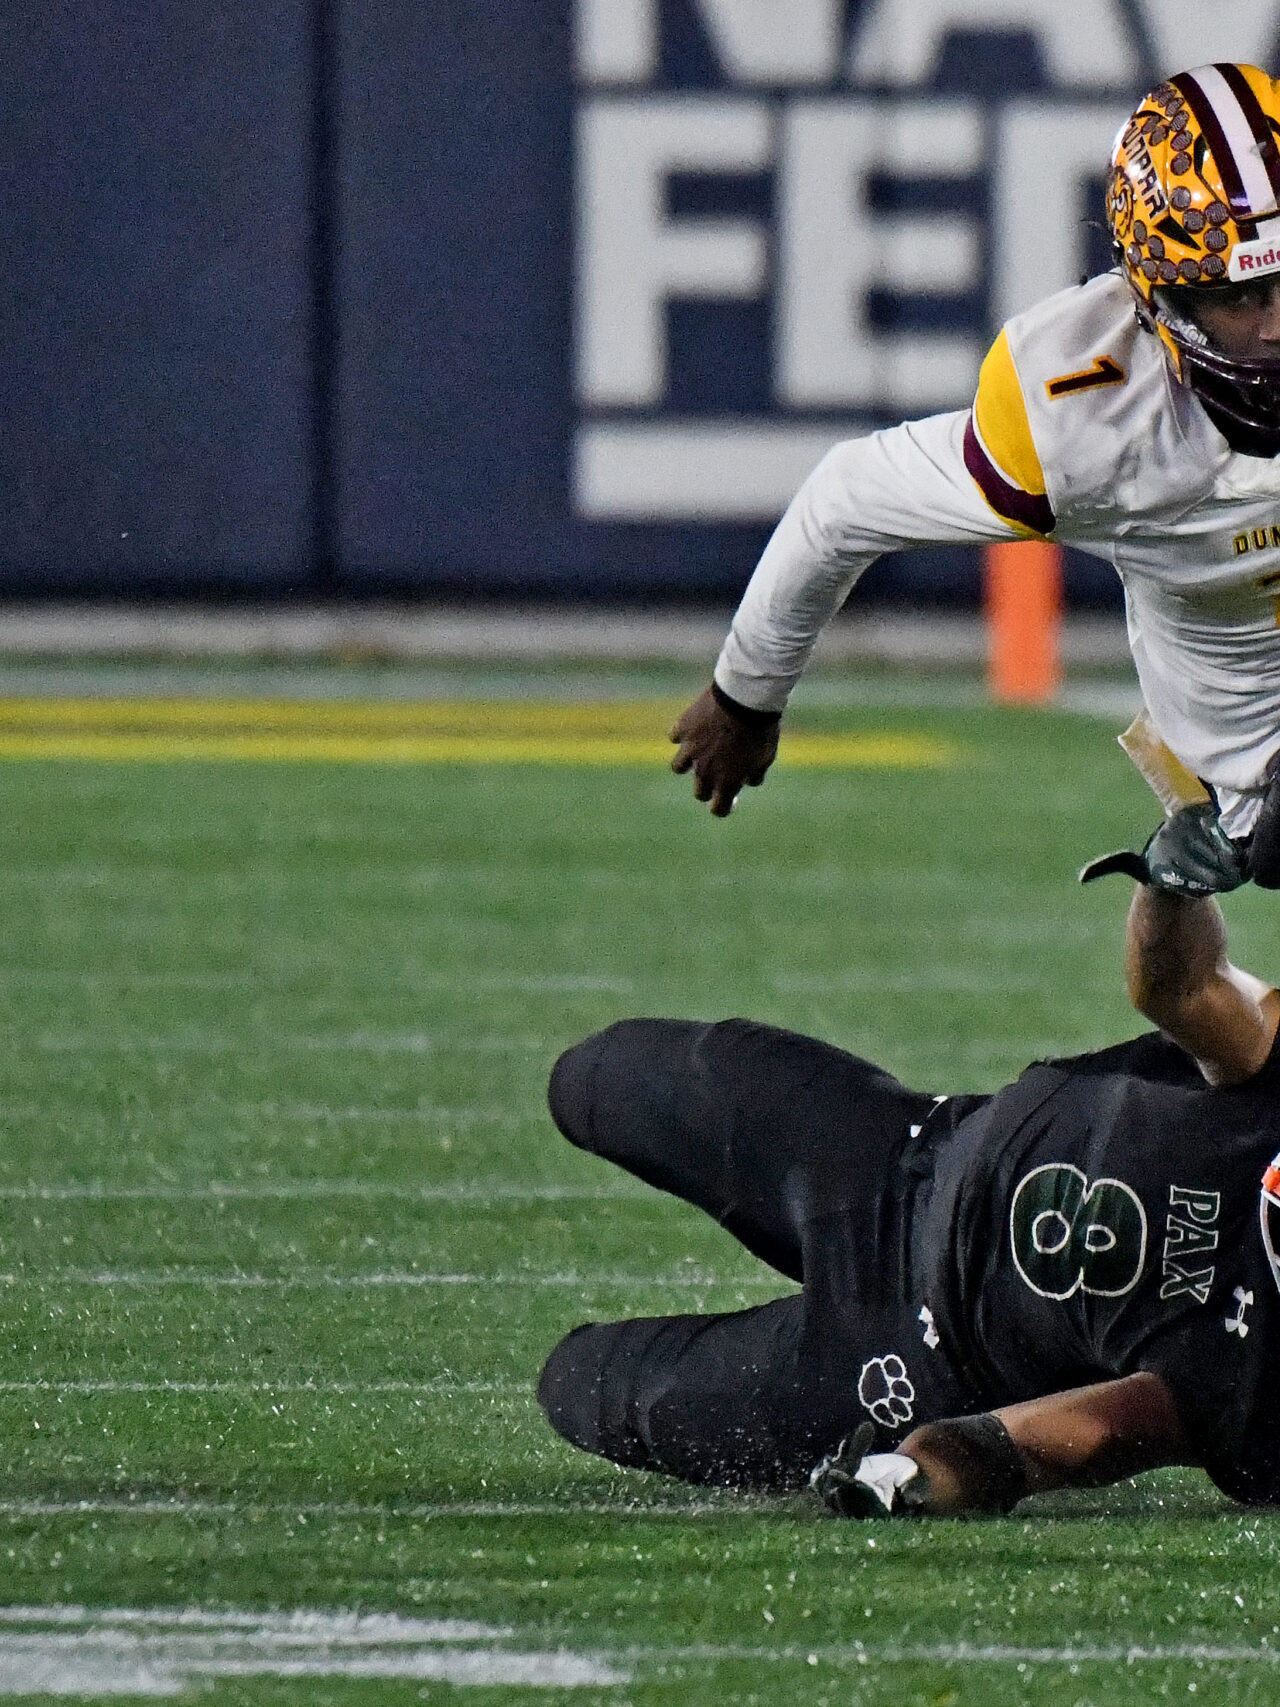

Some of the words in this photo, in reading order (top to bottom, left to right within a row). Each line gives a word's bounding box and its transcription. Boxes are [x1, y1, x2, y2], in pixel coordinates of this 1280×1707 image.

[1044, 355, 1127, 401] 1
[1011, 1162, 1147, 1301] 8
[1160, 1185, 1221, 1304] PAX
